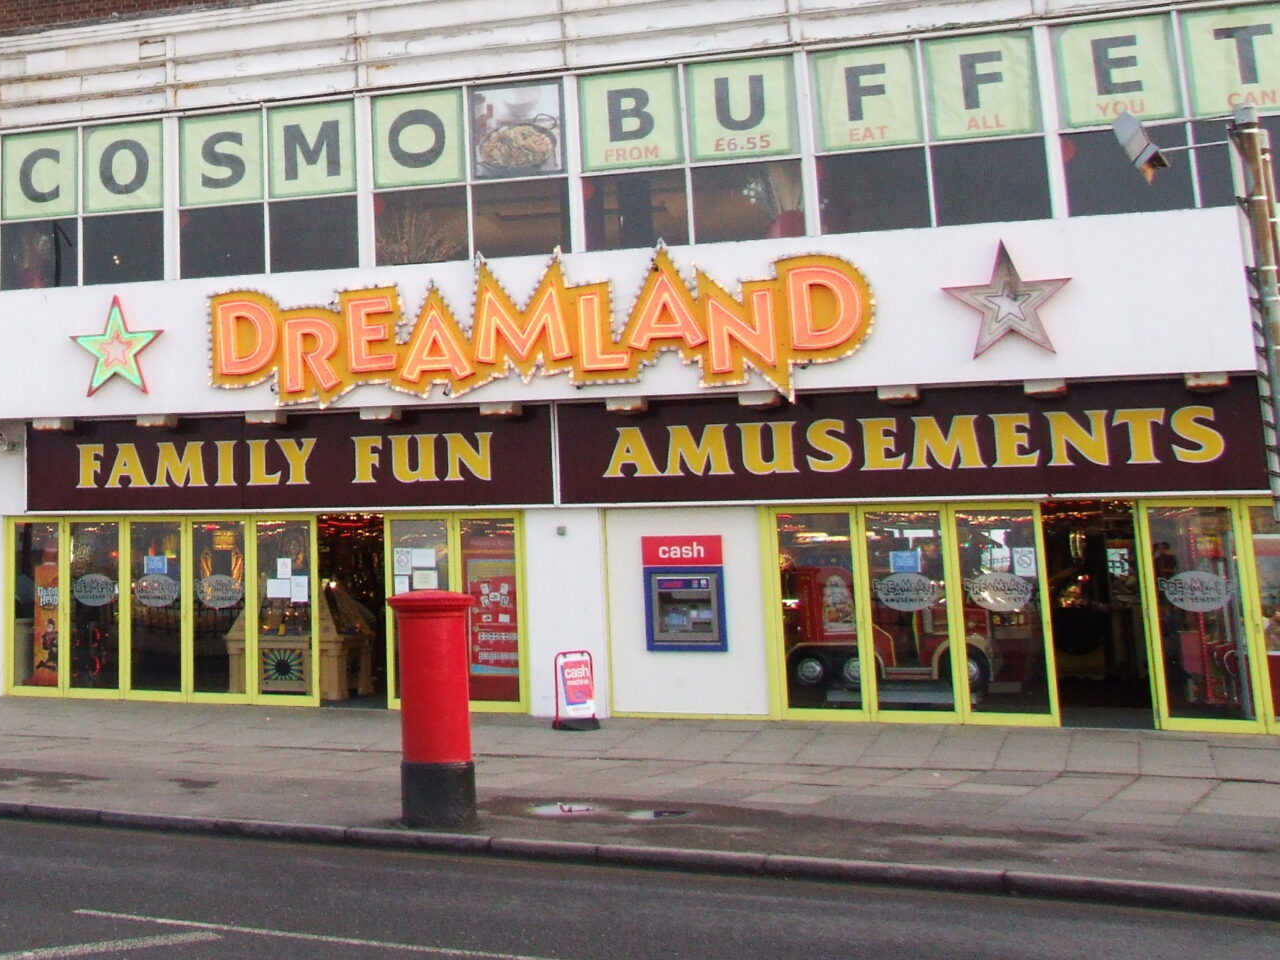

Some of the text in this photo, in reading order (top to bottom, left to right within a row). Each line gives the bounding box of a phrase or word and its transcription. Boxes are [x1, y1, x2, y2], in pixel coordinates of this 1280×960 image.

[18, 23, 1273, 204] COSMO BUFFET
[603, 89, 1278, 163] FROM £6.55 EAT ALL YOU CAN
[211, 260, 868, 396] DREAMLAND
[76, 431, 493, 489] FAMILY FUN
[602, 404, 1227, 480] AMUSEMENTS
[658, 541, 705, 558] cash
[564, 664, 589, 679] cash
